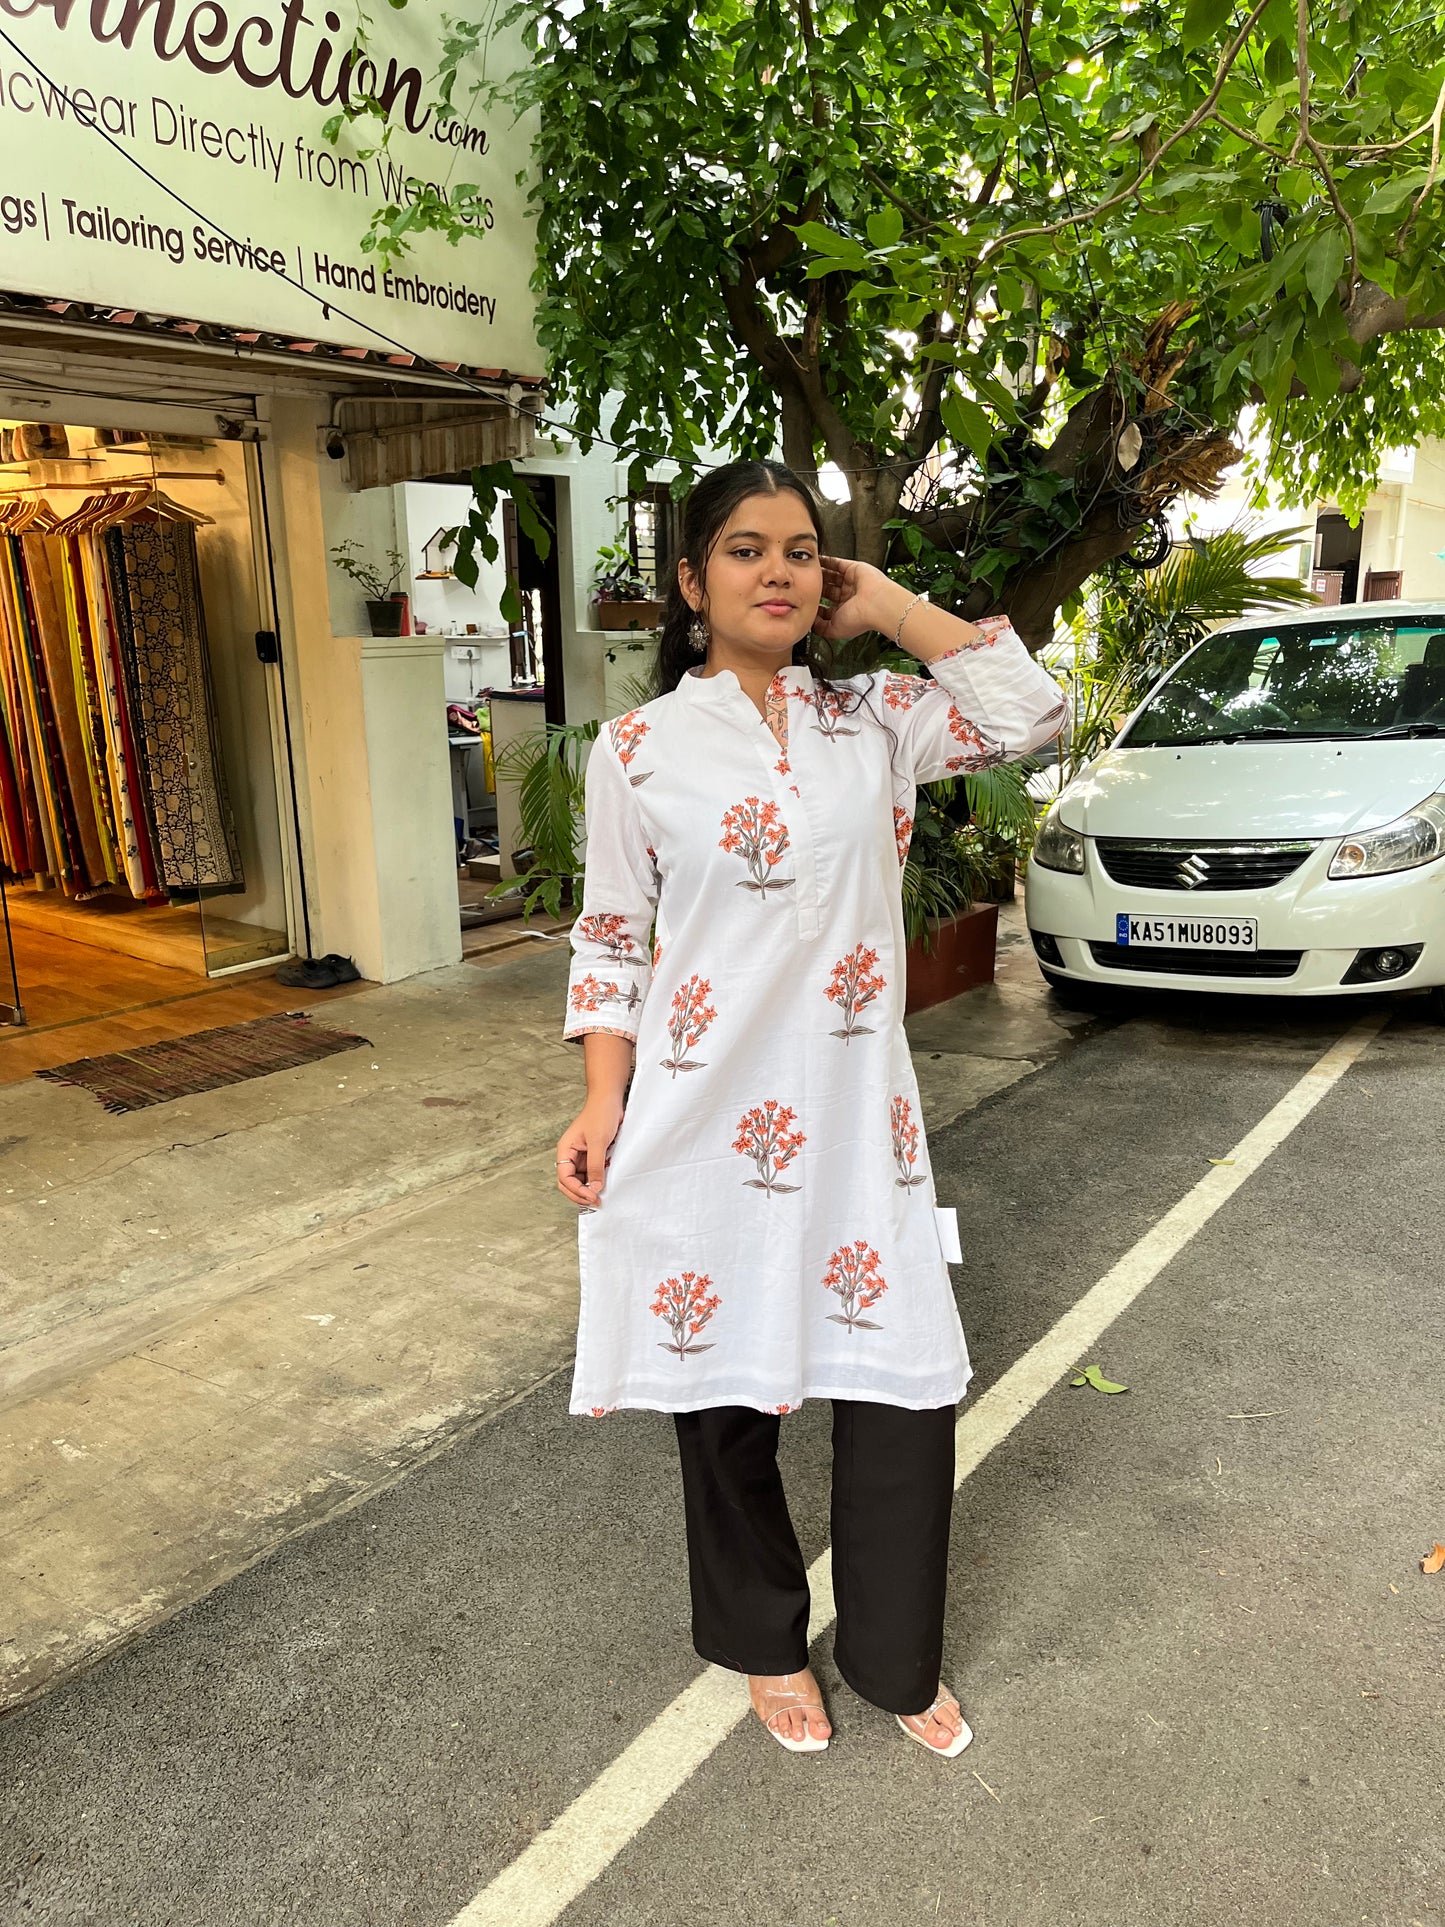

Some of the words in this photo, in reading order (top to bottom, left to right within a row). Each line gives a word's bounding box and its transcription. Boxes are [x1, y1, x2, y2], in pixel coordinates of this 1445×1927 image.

[152, 97, 284, 183] Directly
[295, 137, 368, 197] from
[62, 199, 185, 264] Tailoring
[193, 226, 286, 274] Service
[314, 252, 376, 294] Hand
[383, 268, 496, 325] Embroidery
[1130, 921, 1253, 945] KA51MU8093
